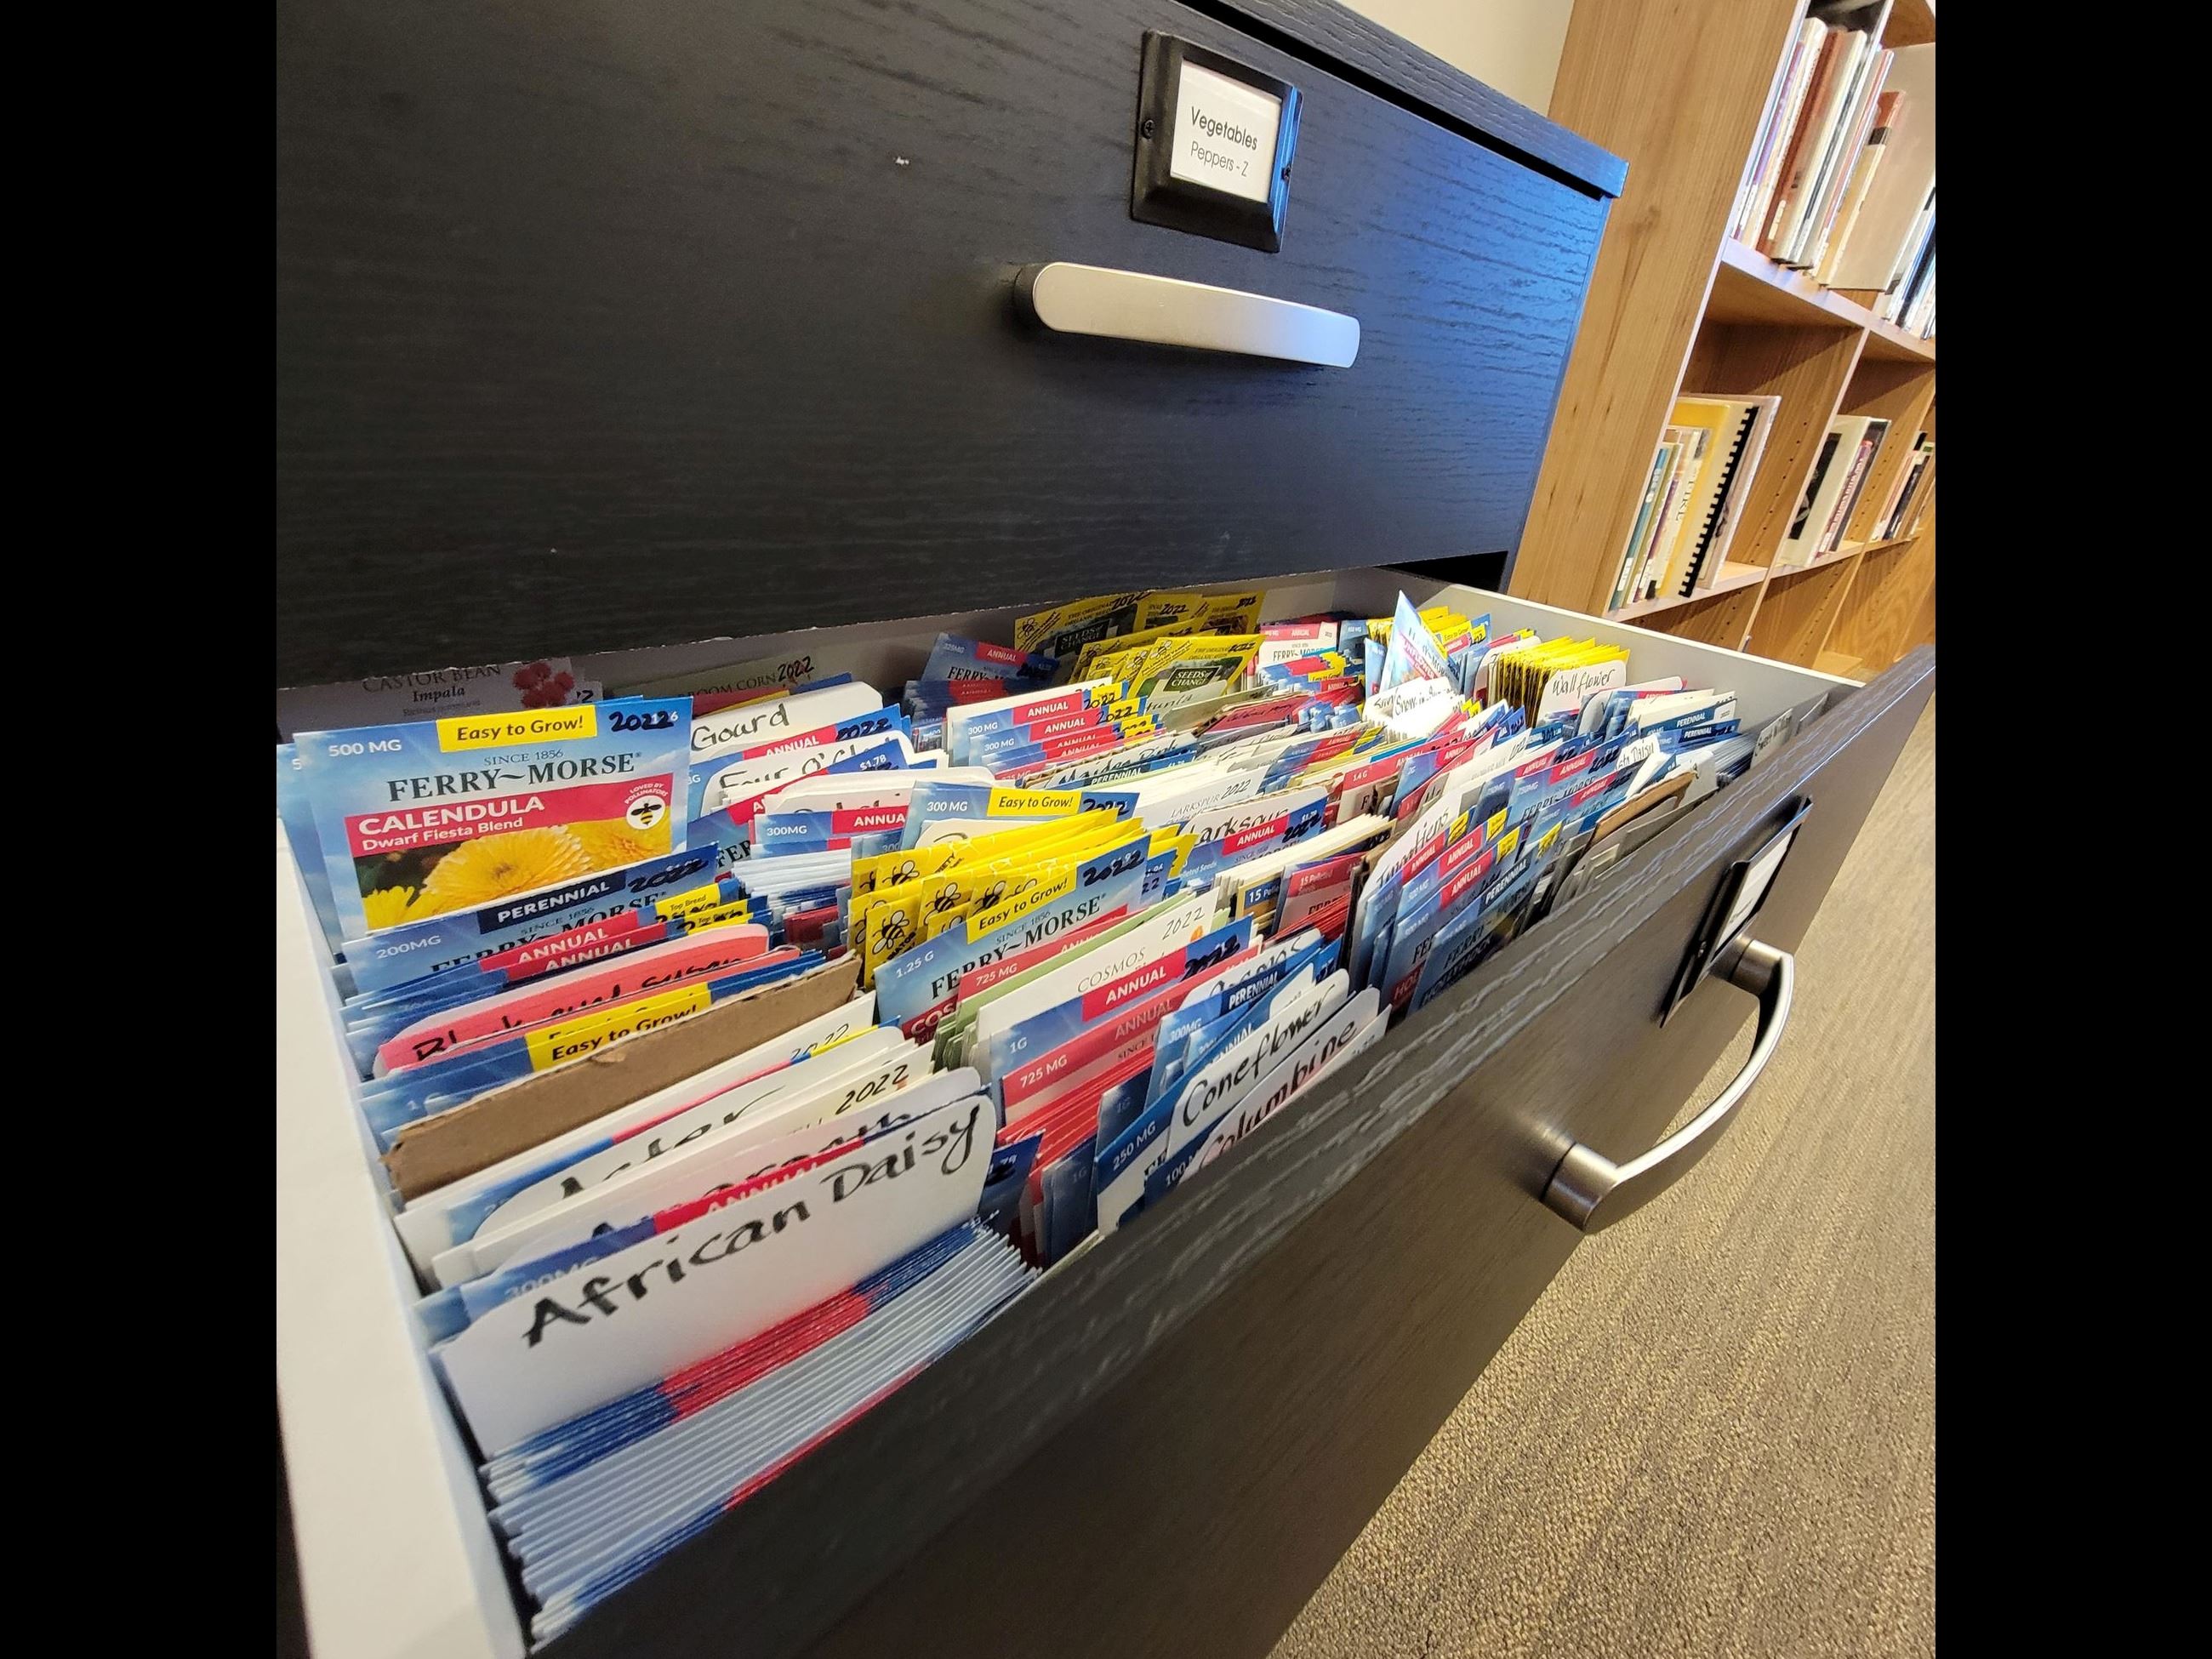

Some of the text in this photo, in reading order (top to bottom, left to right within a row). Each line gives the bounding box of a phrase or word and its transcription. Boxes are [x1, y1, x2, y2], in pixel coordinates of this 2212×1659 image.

[1191, 105, 1258, 151] Vegetables
[1191, 140, 1234, 172] Peppers
[1240, 161, 1249, 177] Z
[987, 649, 1017, 662] ANNUAL
[452, 665, 501, 682] BEAN
[777, 655, 815, 682] 2022
[1175, 670, 1205, 679] SEEDS
[736, 673, 777, 691] CORN
[413, 687, 465, 704] Impala
[1084, 693, 1124, 710] 2022
[1027, 701, 1069, 717] ANNUAL
[1096, 706, 1138, 725] 2022
[1676, 712, 1707, 727] PERENNIAL
[457, 715, 583, 741] Easy to Grow!
[609, 710, 674, 733] 2022
[690, 703, 790, 752] Gourd
[967, 721, 998, 736] 300 MG
[1044, 717, 1086, 734] ANNUAL
[1684, 727, 1712, 738] PERENNIAL
[328, 738, 402, 757] 500 MG
[766, 735, 819, 756] ANNUAL
[984, 737, 1015, 751] 300 MG
[483, 749, 563, 766] SINCE 1856
[1091, 767, 1143, 785] PERENNIAL
[624, 788, 669, 805] POLLINATORS
[630, 783, 653, 794] LOVED
[926, 801, 968, 812] 300 MG
[998, 795, 1074, 809] Easy to Grow!
[358, 795, 544, 835] CALENDULA
[853, 813, 905, 827] ANNUA
[362, 817, 523, 851] Dwarf Fiesta Blend
[767, 825, 807, 837] 300MG
[1237, 825, 1275, 847] ANNUAL
[1446, 837, 1474, 867] ANNUAL
[1451, 864, 1482, 897] ANNUAL
[1485, 858, 1528, 905] PERENNIAL
[498, 881, 610, 923] PERENNIAL
[670, 895, 707, 912] Top Breed
[979, 877, 1069, 931] Easy to Grow!
[1248, 886, 1262, 904] 15
[1162, 907, 1206, 940] 2022
[376, 935, 442, 961] 200MG
[518, 926, 609, 964] ANNUAL
[544, 938, 636, 972] ANNUAL
[896, 951, 935, 978] 1.25 G
[976, 962, 1018, 987] 725 MG
[1078, 946, 1146, 994] COSMOS
[1105, 966, 1168, 1005] ANNUAL
[1229, 971, 1279, 1010] PERENNIAL
[1115, 999, 1173, 1040] ANNUAL
[552, 1035, 602, 1061] Easy
[608, 1025, 630, 1041] to
[1009, 1037, 1028, 1054] 1G
[1183, 983, 1335, 1127] Coneflower
[1020, 1054, 1068, 1089] 725 MG
[835, 1063, 909, 1115] 2022
[1112, 1143, 1134, 1169] 250
[1136, 1120, 1157, 1148] MG
[522, 1198, 812, 1348] African
[819, 1103, 981, 1203] Daisy
